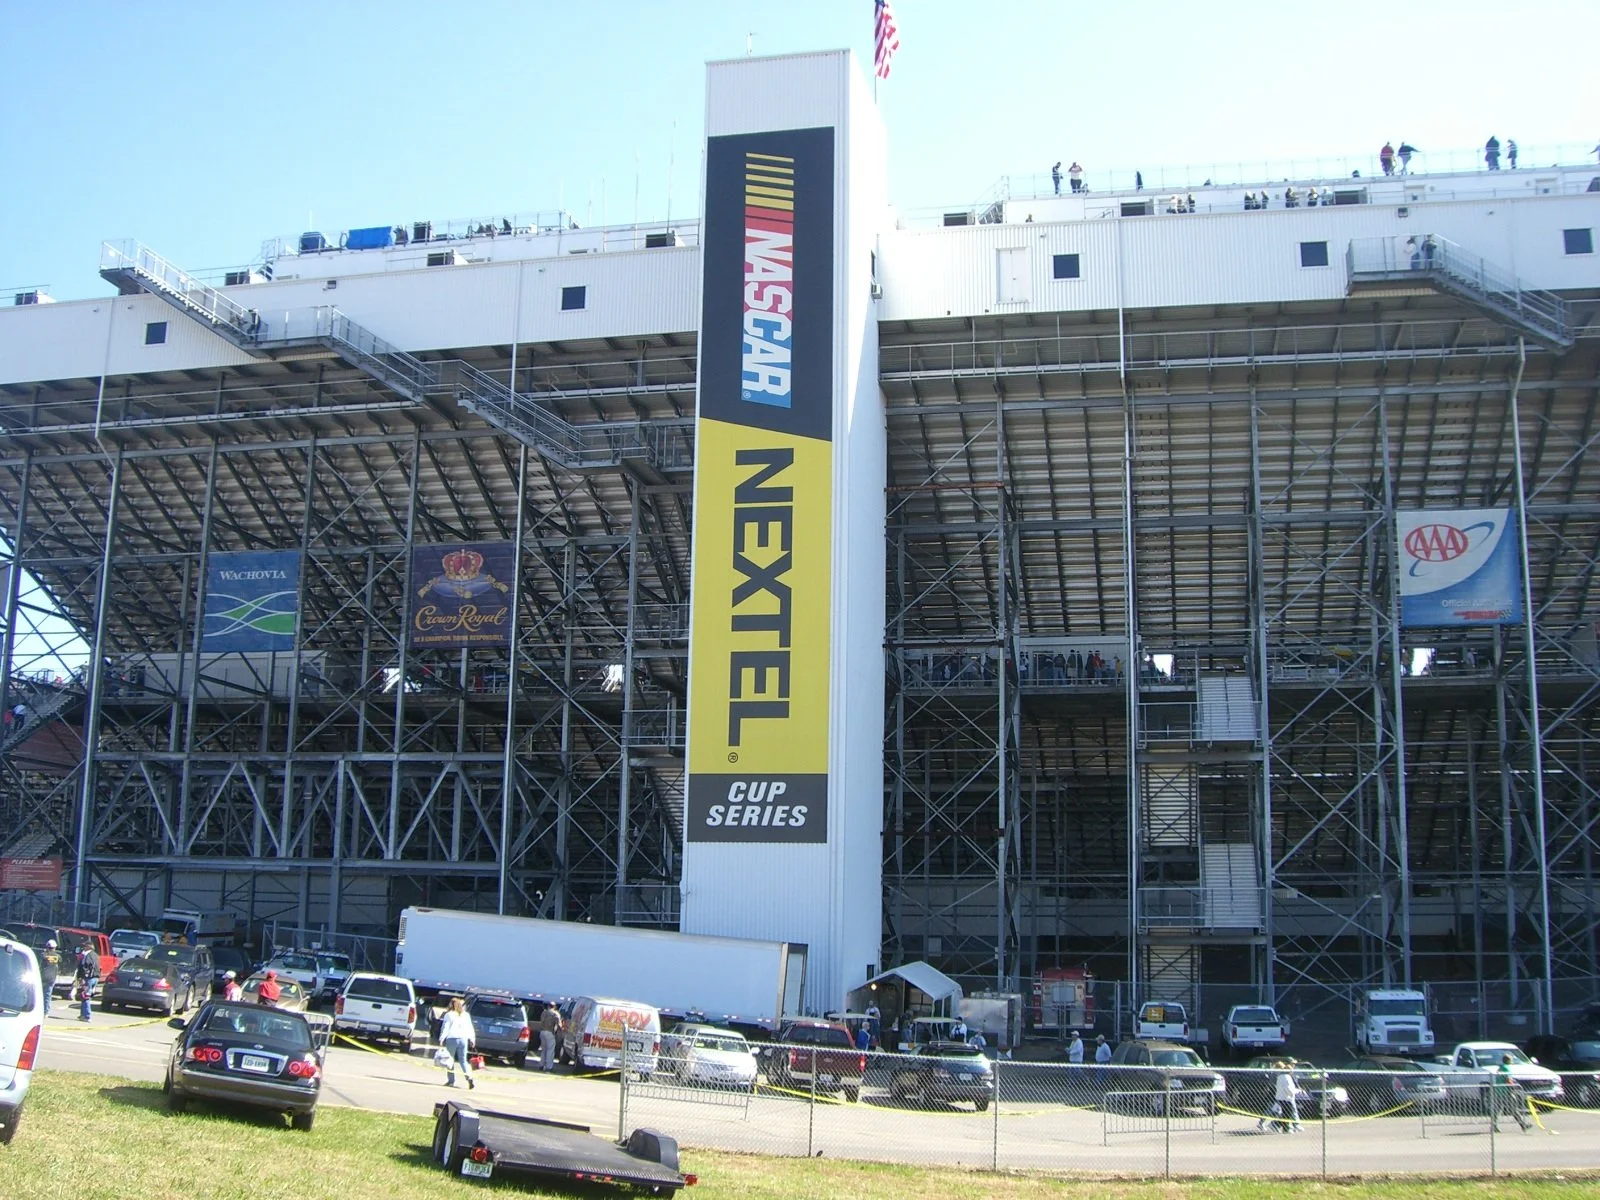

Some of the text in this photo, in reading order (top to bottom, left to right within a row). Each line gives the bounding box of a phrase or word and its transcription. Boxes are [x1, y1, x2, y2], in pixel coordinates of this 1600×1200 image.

[742, 227, 793, 396] NASCAR
[1412, 525, 1462, 560] AAA
[219, 570, 288, 581] WACHOVIA
[728, 448, 795, 747] NEXTEL
[414, 604, 508, 632] Crown Royal
[727, 781, 787, 803] CUP
[705, 804, 809, 827] SERIES
